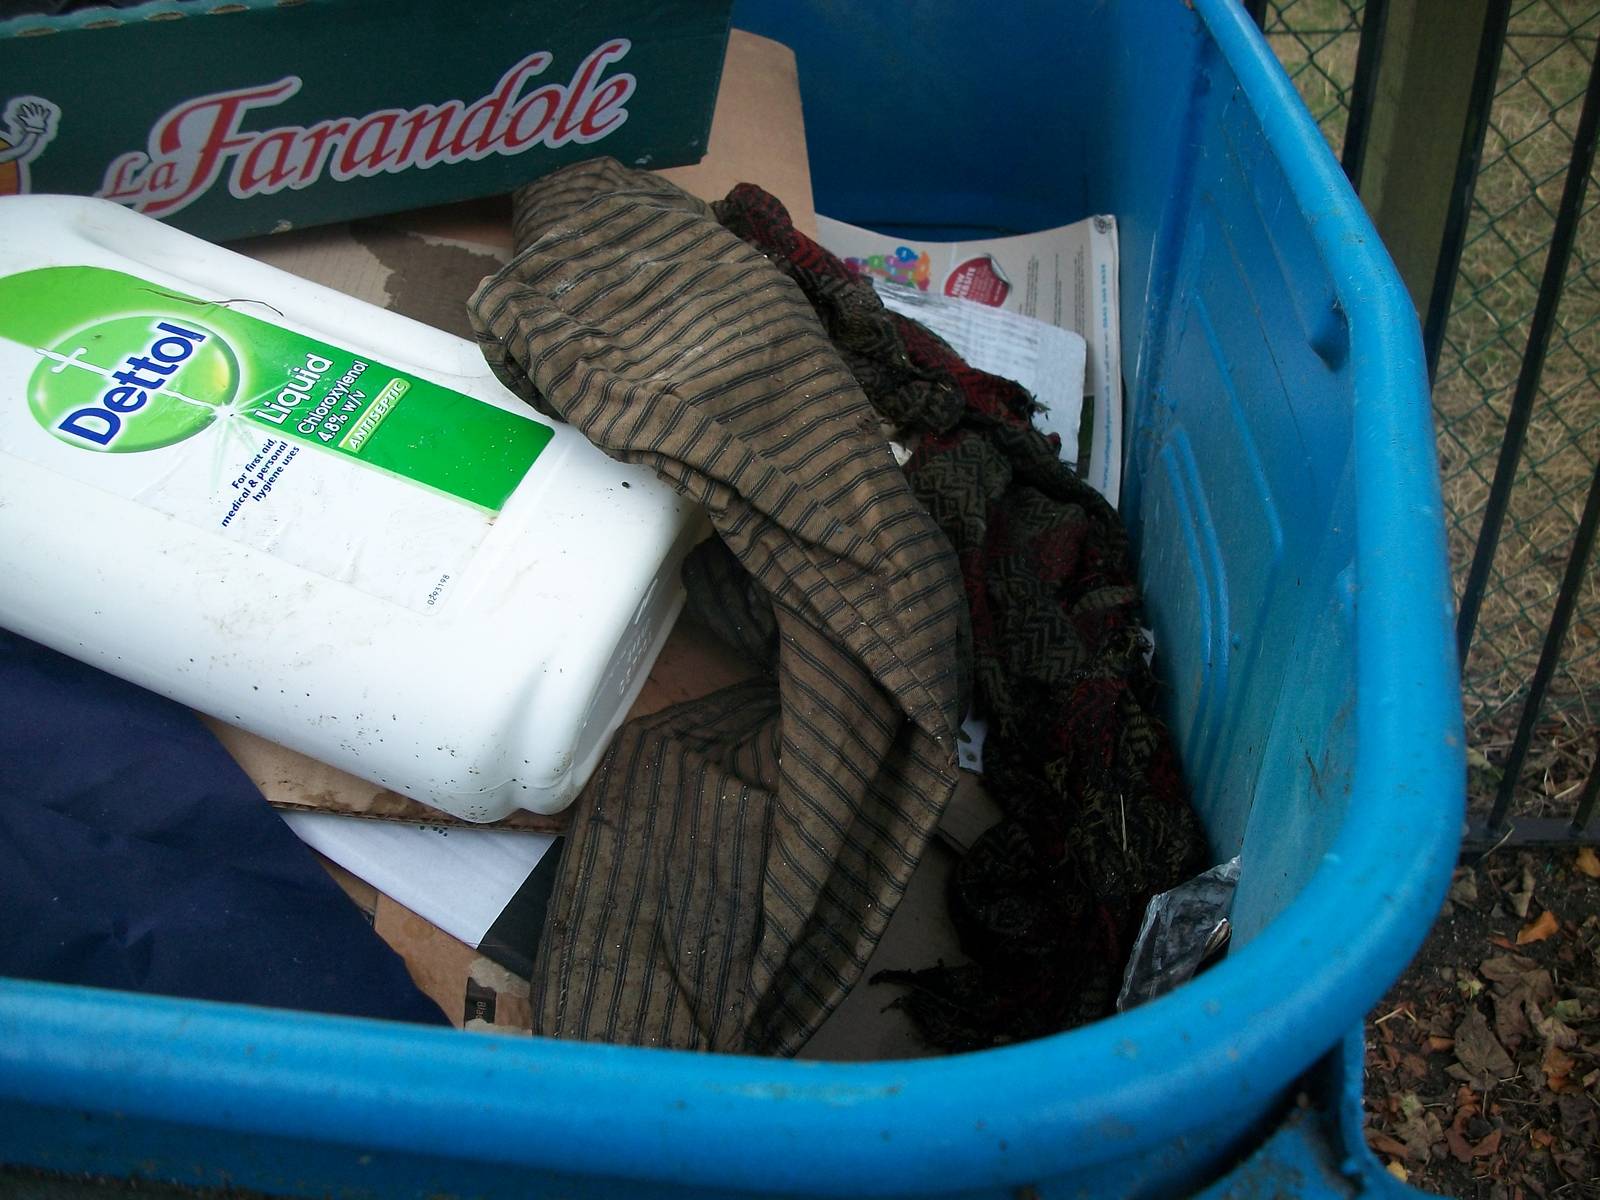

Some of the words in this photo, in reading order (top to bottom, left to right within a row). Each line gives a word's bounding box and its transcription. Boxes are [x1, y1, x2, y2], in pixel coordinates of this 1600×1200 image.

[141, 42, 631, 213] Farandole
[58, 322, 206, 445] Dettol
[254, 353, 333, 424] Liquid
[297, 360, 368, 434] Chloroxylenol
[350, 381, 407, 449] ANTISEPTIC
[317, 414, 349, 442] 4.8%
[221, 487, 251, 527] medical
[249, 479, 259, 489] &
[256, 441, 289, 480] personal
[231, 472, 248, 489] For
[245, 453, 264, 472] first
[261, 439, 278, 456] aid,
[252, 466, 284, 502] hygiene
[282, 446, 300, 466] uses
